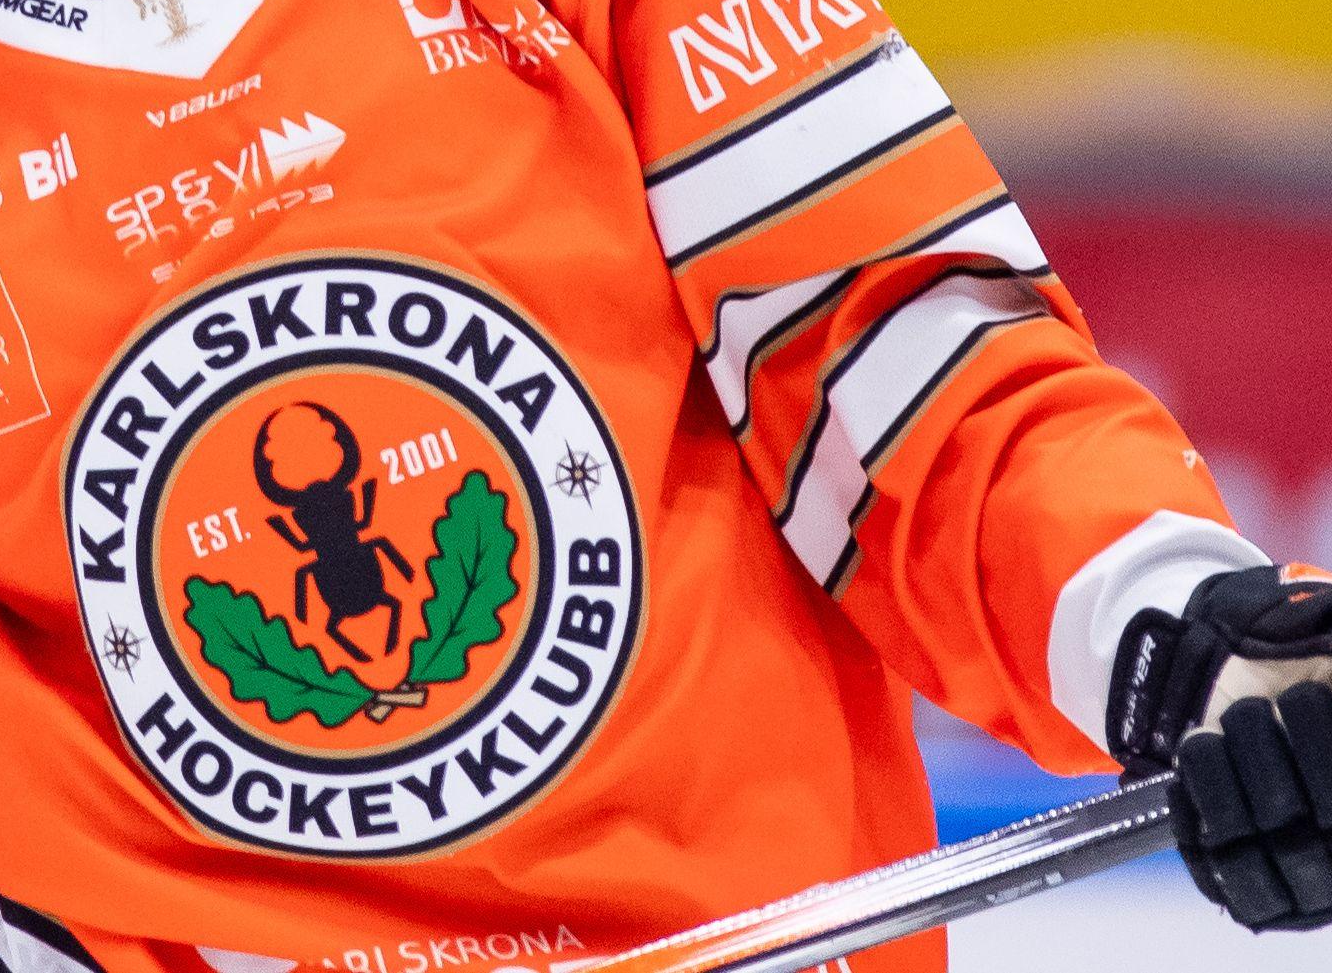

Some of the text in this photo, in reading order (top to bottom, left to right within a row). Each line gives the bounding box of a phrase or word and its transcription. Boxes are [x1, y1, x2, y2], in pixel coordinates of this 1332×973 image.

[169, 73, 262, 124] BAUER
[18, 131, 79, 202] Bil
[82, 281, 559, 585] KARLSKRONA
[379, 427, 459, 485] 2001
[185, 506, 252, 559] EST.
[135, 535, 622, 840] HOCKEYKLUBB
